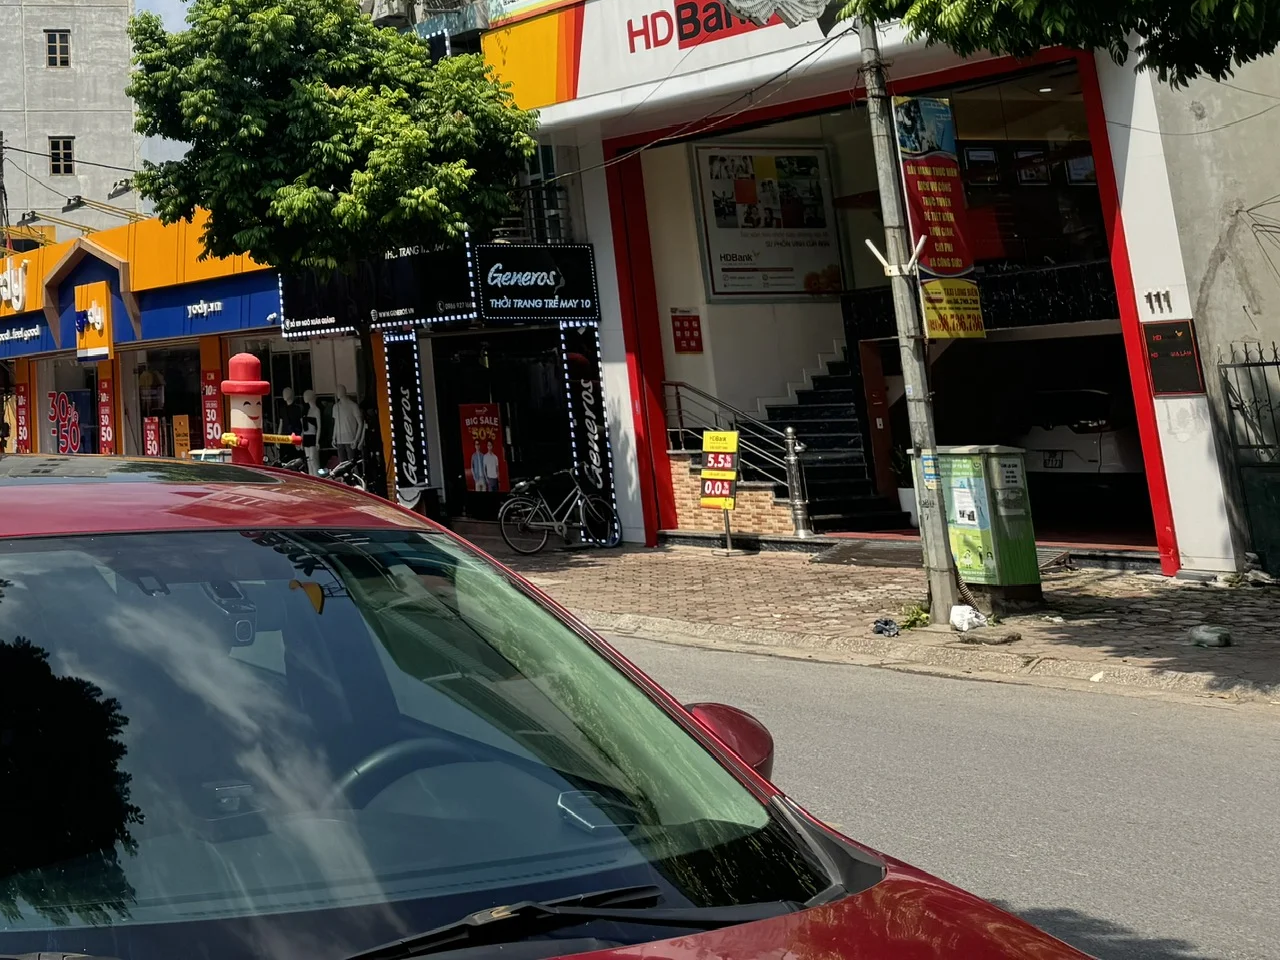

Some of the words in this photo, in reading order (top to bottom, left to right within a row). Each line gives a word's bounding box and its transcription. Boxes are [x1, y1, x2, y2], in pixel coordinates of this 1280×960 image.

[627, 0, 750, 53] HDBa
[399, 245, 419, 257] TRANG
[720, 253, 753, 262] HDBank
[487, 262, 557, 288] Generos
[187, 299, 223, 318] yody.vn
[489, 295, 511, 308] THỜI
[513, 298, 543, 308] TRANG
[544, 295, 559, 308] TRẺ
[560, 299, 579, 308] MAY
[580, 299, 591, 308] 10
[1144, 291, 1172, 314] 111
[206, 409, 216, 421] 30
[465, 416, 478, 426] BIG
[479, 416, 499, 426] SALE
[18, 427, 27, 440] 50
[101, 427, 112, 441] 50
[147, 430, 155, 440] 30
[206, 423, 222, 440] 50
[400, 386, 418, 485] Generos
[471, 427, 496, 440] 50%
[580, 378, 603, 489] Generos
[147, 441, 157, 455] 50
[707, 454, 725, 468] 5.5
[705, 481, 722, 495] 0.0
